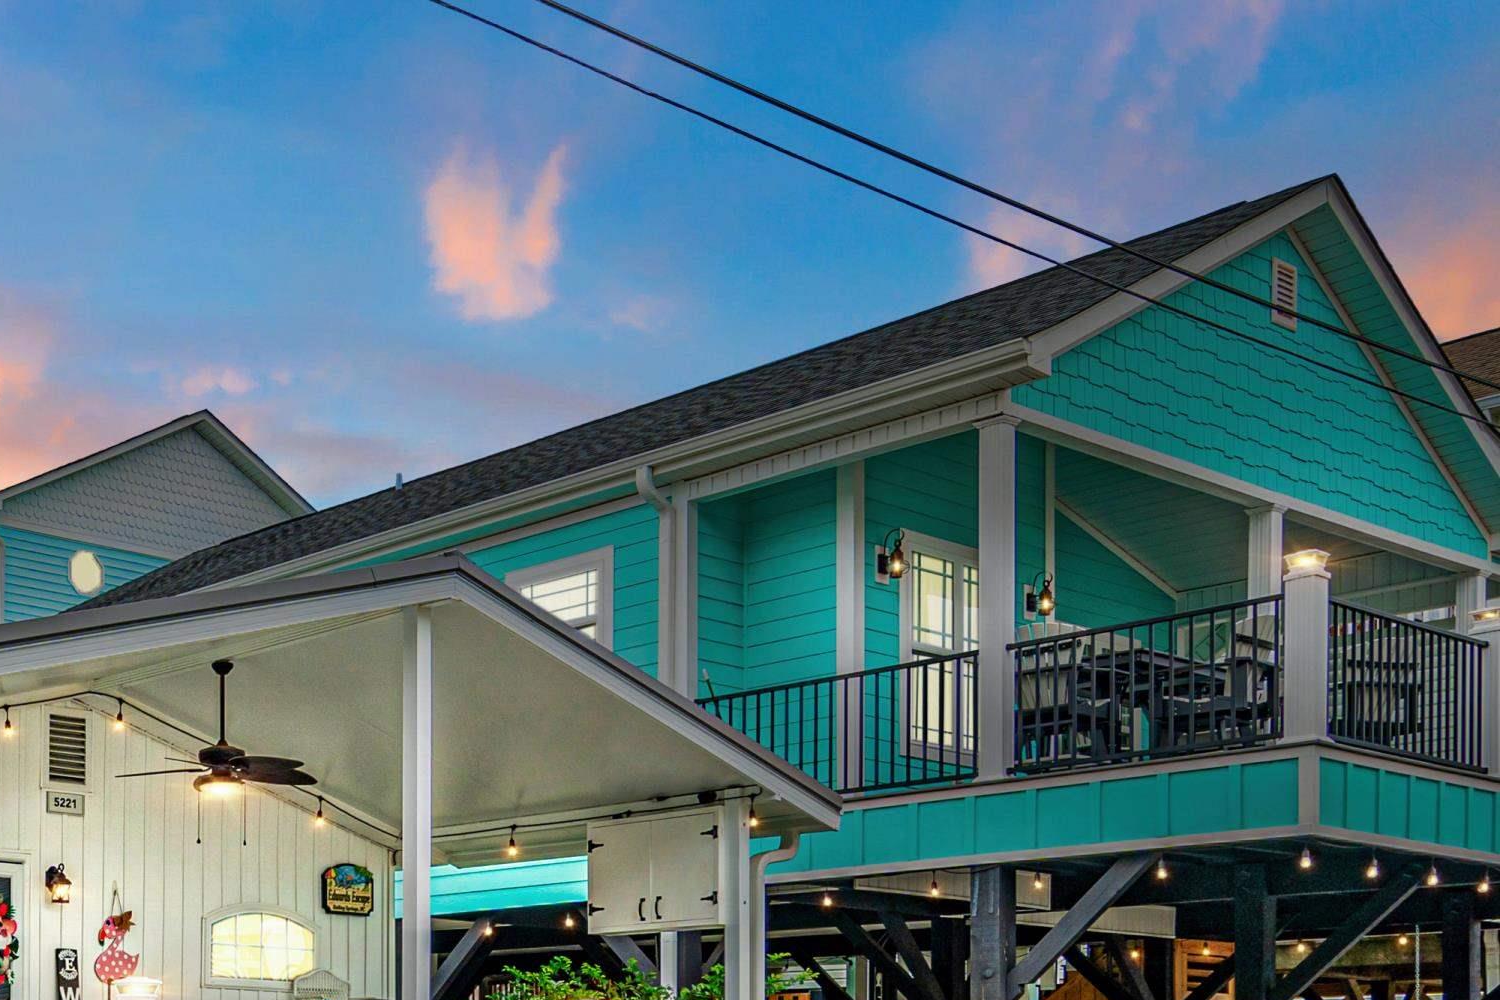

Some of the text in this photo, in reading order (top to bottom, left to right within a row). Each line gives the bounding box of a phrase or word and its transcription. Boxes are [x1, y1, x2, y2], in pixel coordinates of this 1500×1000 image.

[54, 797, 77, 809] 5221
[352, 890, 371, 905] Escape
[64, 958, 76, 971] E
